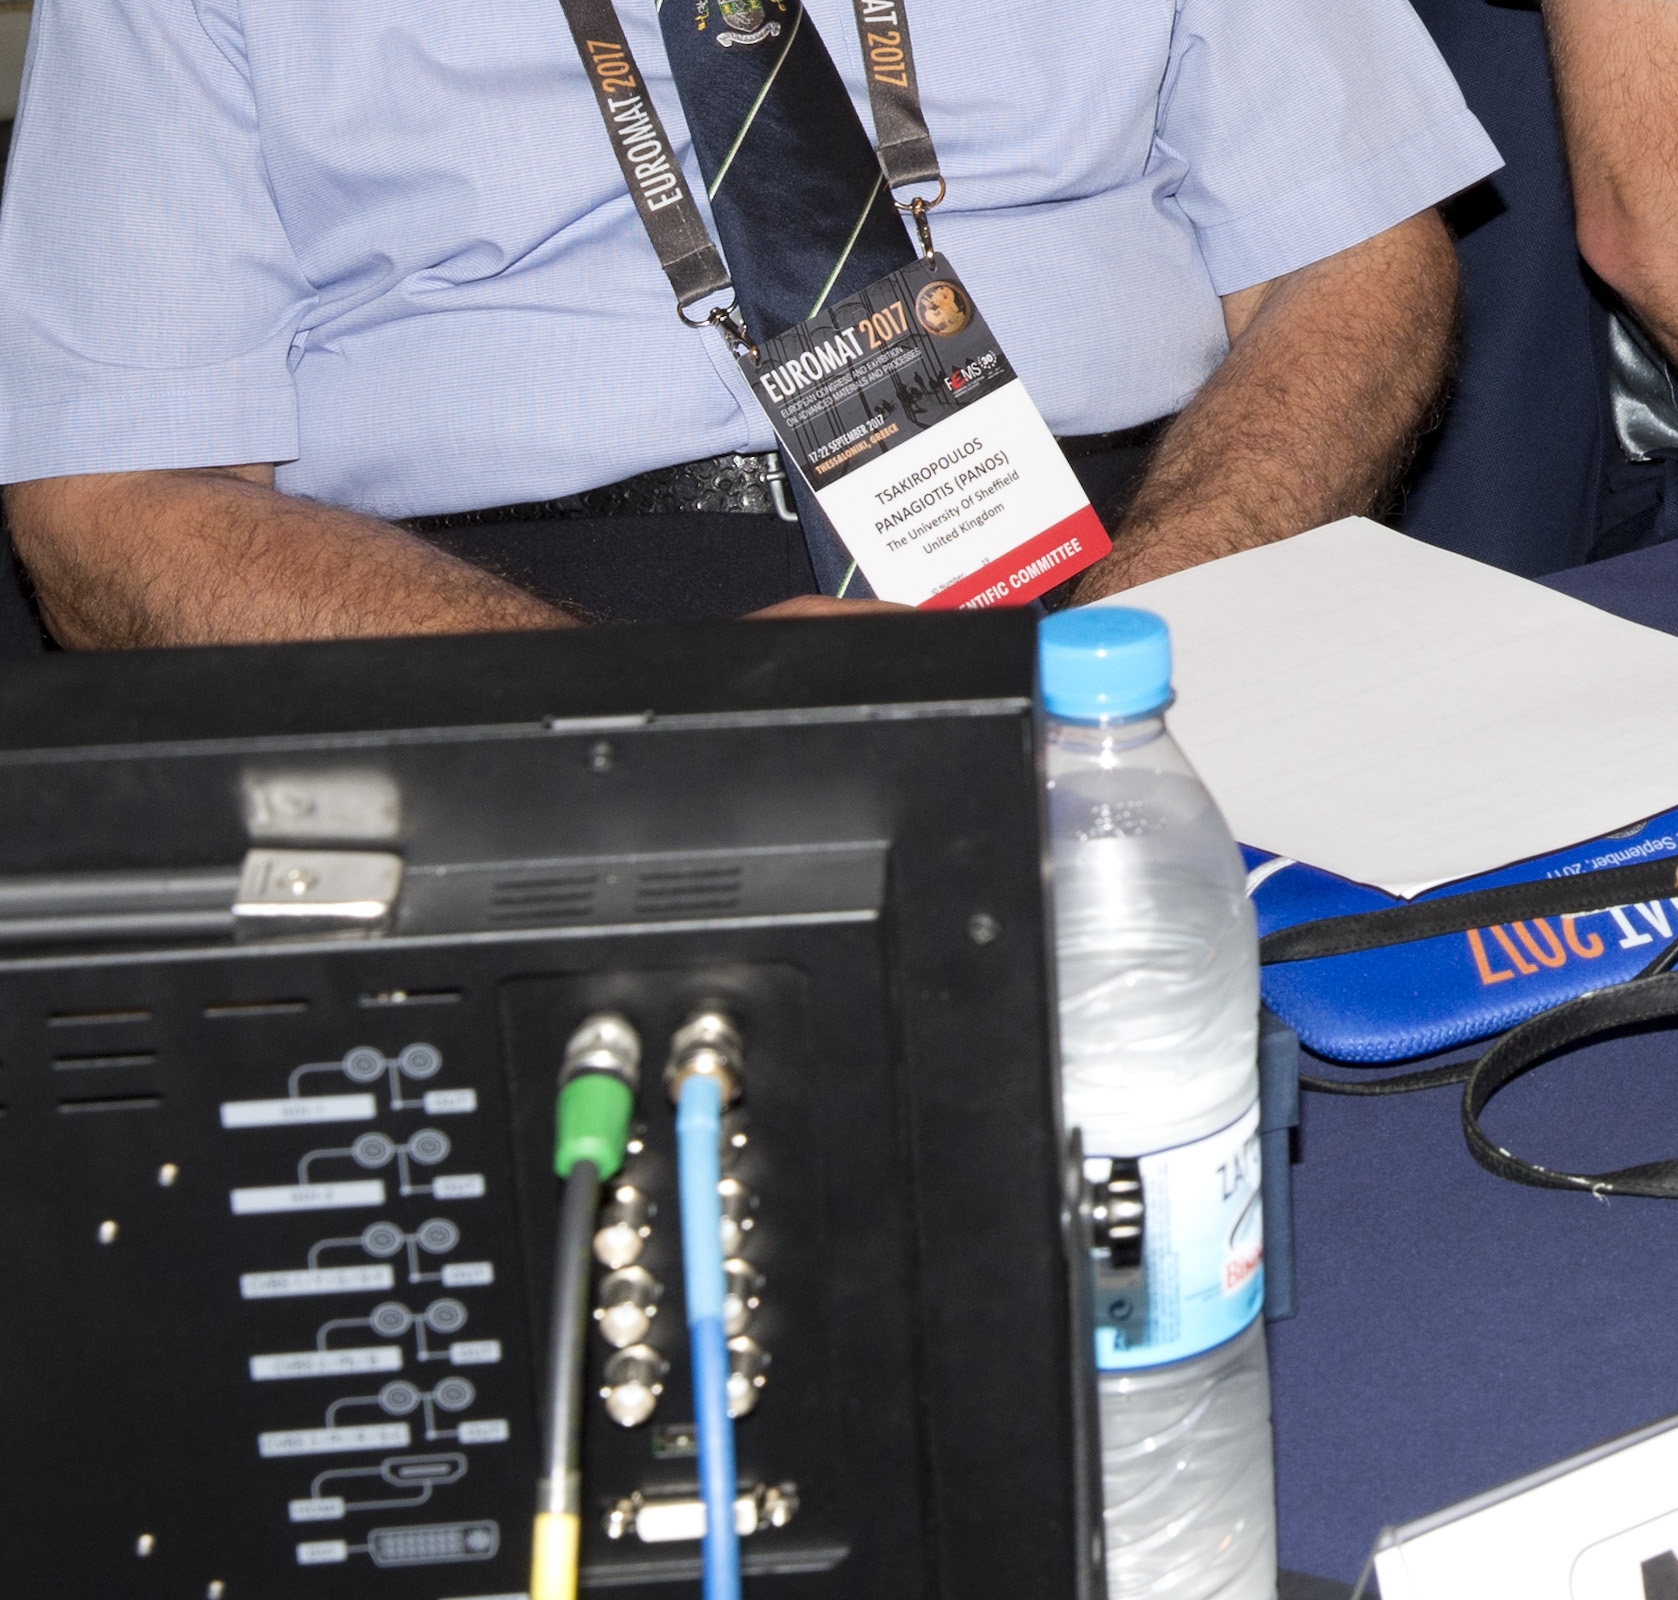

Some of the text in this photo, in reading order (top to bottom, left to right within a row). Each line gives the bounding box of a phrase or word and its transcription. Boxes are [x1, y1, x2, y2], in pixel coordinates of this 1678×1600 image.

[867, 30, 909, 87] 2017
[586, 39, 684, 212] EUROMAT 2017
[760, 301, 909, 403] EUROMAT 2017
[781, 347, 904, 419] EUROPEAN CONGRESS AND EXHIBITION
[785, 347, 922, 428] ON ADVANCED MATERIALS AND PROCESSES
[944, 362, 982, 391] FEMS
[815, 423, 899, 475] THESSALONIKI, GREECE
[827, 422, 869, 452] SEPTEMBER
[866, 414, 885, 432] 2017
[875, 437, 984, 505] TSAKIROPOULOS
[875, 450, 1010, 534] PANAGIOTIS (PANOS)
[886, 469, 1020, 553] The University Of Sheffield
[923, 502, 1006, 555] United Kingdom
[959, 537, 1083, 609] NTIFIC COMMITTEE
[1584, 835, 1677, 873] September,
[1464, 915, 1606, 986] 2017
